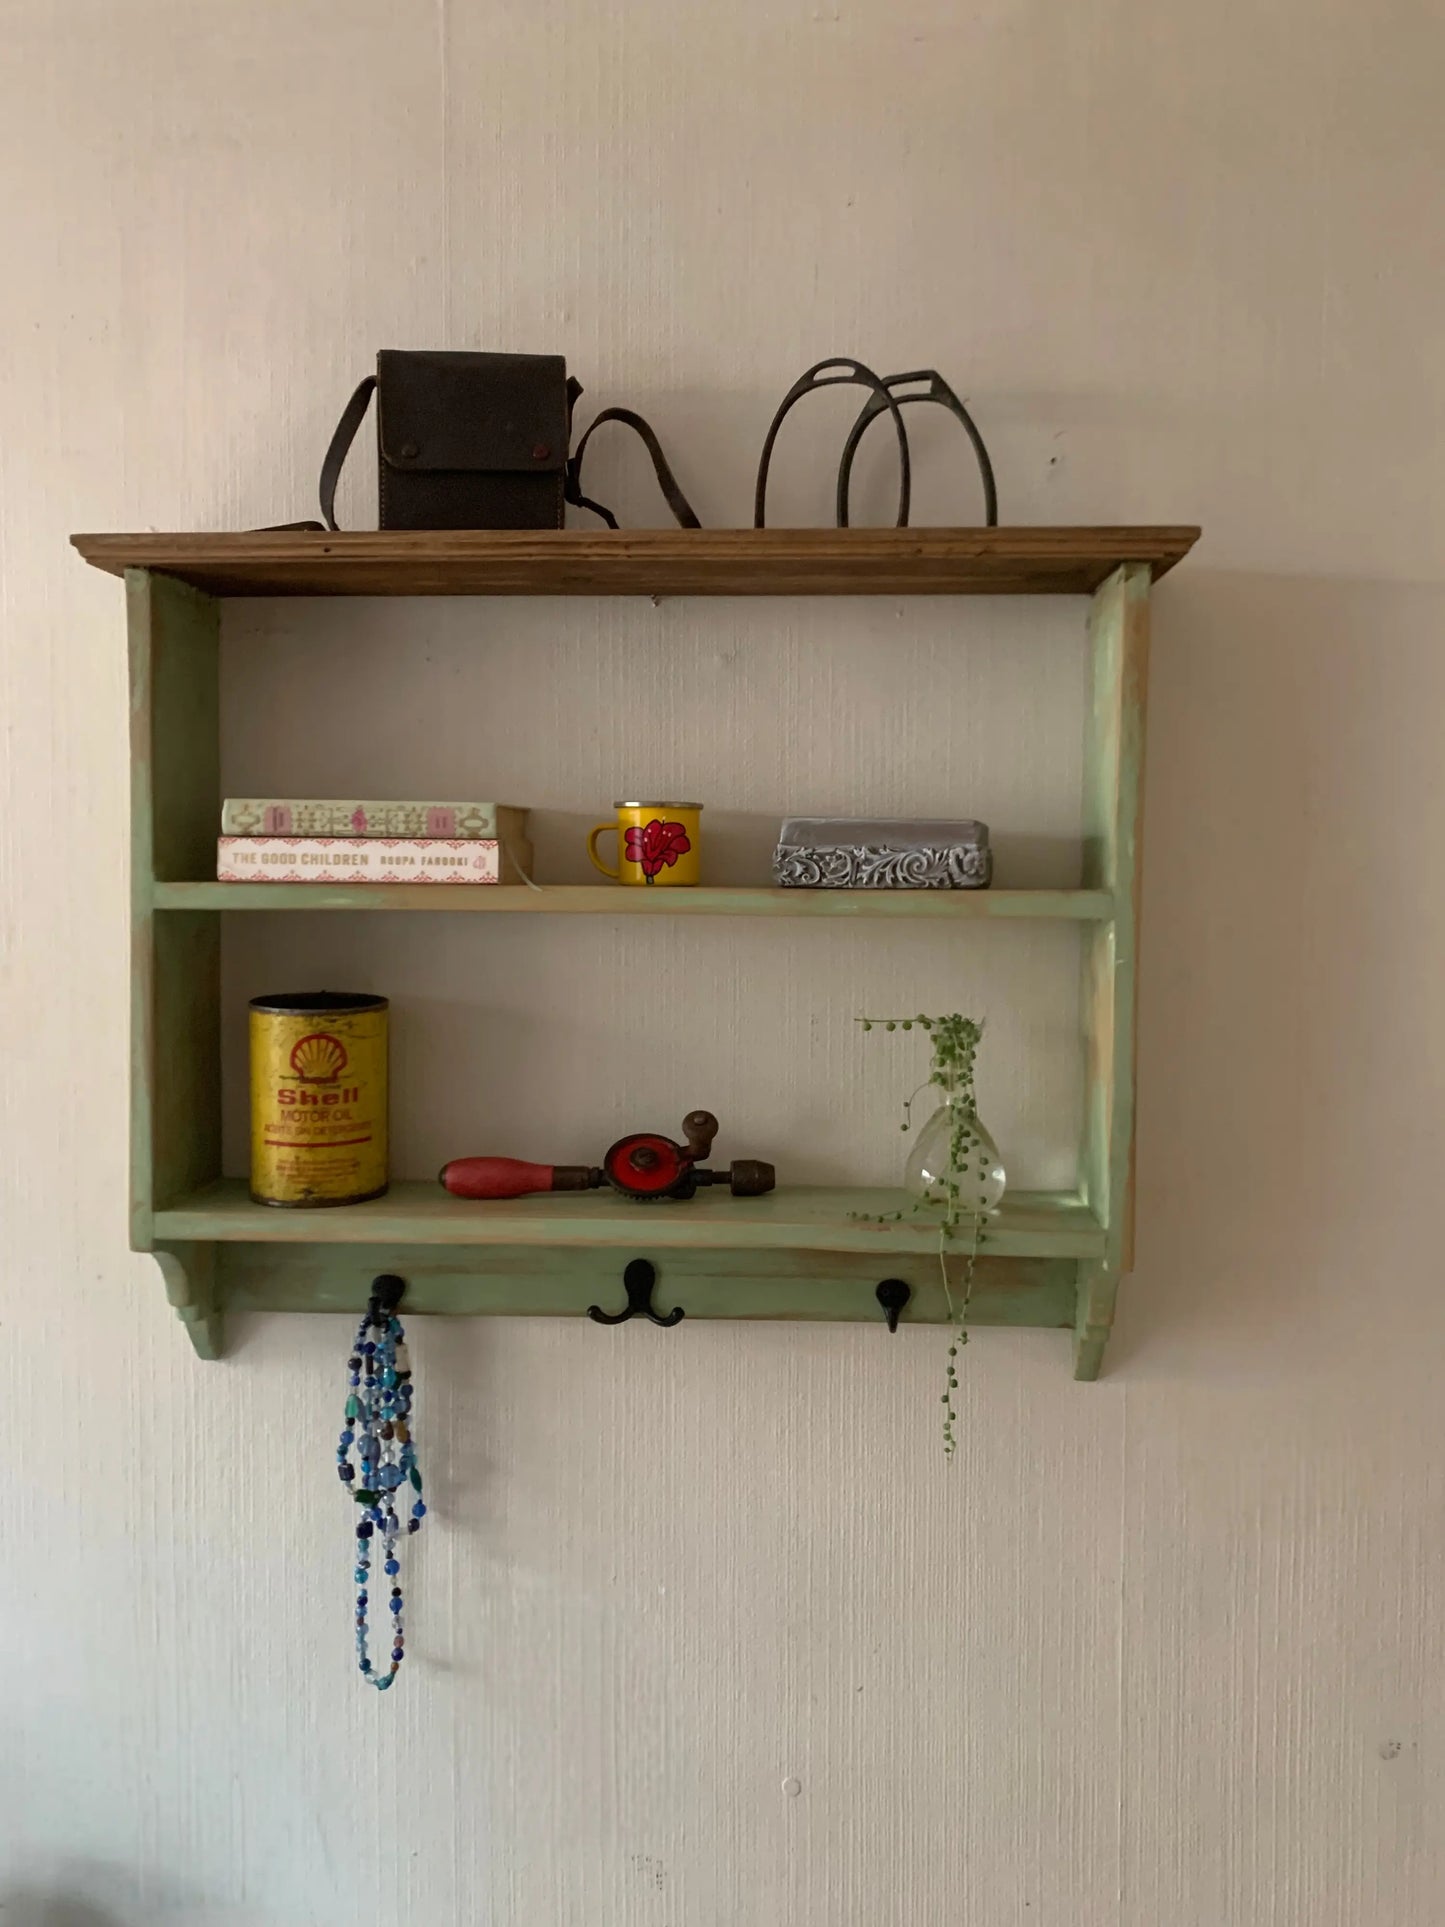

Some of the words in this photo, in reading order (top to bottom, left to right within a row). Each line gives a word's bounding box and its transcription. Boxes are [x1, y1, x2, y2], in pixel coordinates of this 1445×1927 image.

[233, 853, 257, 864] THE
[261, 853, 297, 865] GOOD
[301, 854, 368, 866] CHILDREN
[278, 1087, 358, 1105] Shell
[280, 1109, 329, 1122] MOTOR
[333, 1109, 353, 1121] OIL
